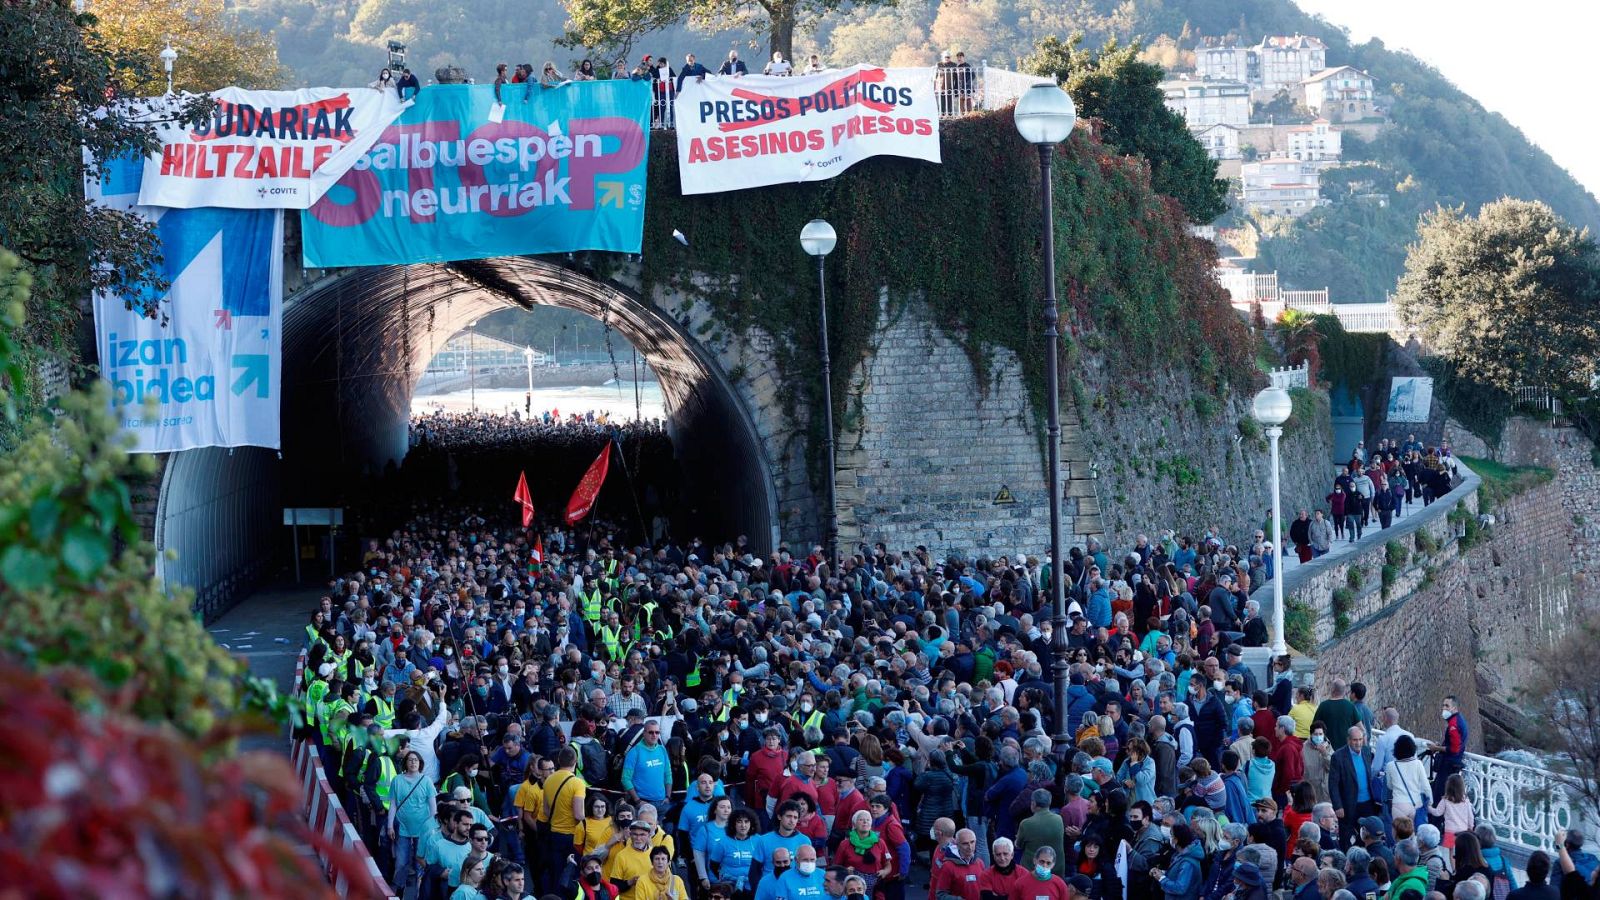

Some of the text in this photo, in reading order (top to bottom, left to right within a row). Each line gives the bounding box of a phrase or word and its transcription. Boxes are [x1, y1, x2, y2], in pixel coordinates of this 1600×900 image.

[700, 97, 791, 123] PRESOS
[688, 115, 933, 163] ASESINOS PRESOS
[160, 142, 345, 179] HILTZAILE
[817, 155, 843, 168] COVITE
[269, 187, 297, 195] COVITE
[383, 169, 573, 218] neurriak
[108, 332, 187, 369] izan
[110, 368, 215, 408] bidea
